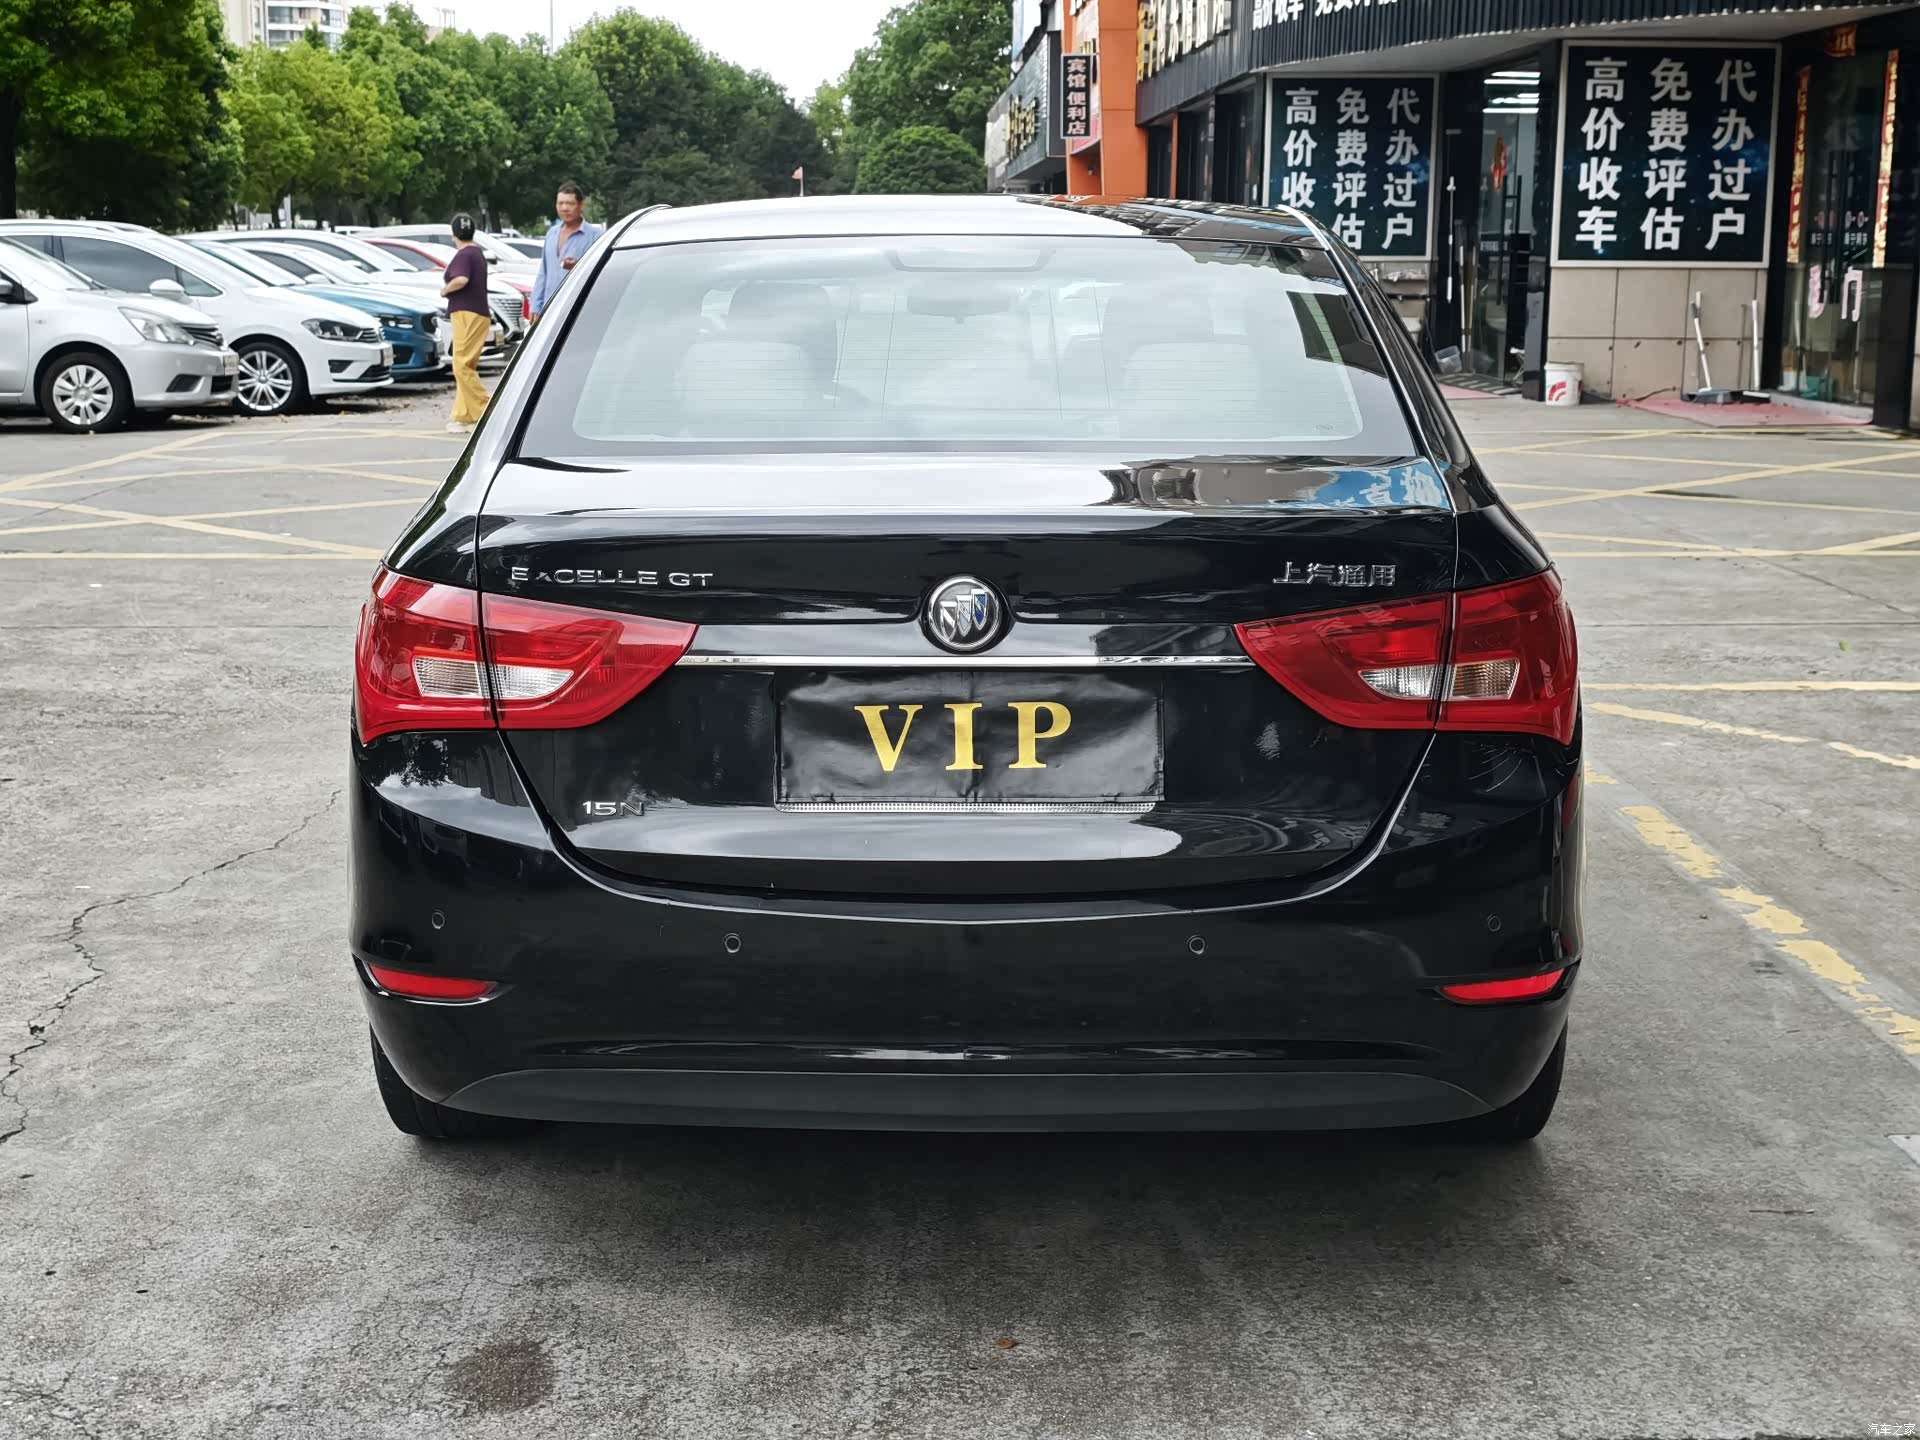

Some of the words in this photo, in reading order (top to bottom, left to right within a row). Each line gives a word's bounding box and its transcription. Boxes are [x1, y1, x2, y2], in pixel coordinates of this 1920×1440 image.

[1331, 87, 1370, 250] 免费评估
[1381, 88, 1421, 250] 代办过户
[1575, 57, 1628, 250] 高价收车
[1640, 57, 1692, 251] 免费评估
[1705, 59, 1758, 251] 代办过户
[668, 572, 714, 587] GT
[1272, 561, 1397, 587] 上汽通用
[582, 801, 645, 817] 15N
[854, 701, 1072, 772] VIP
